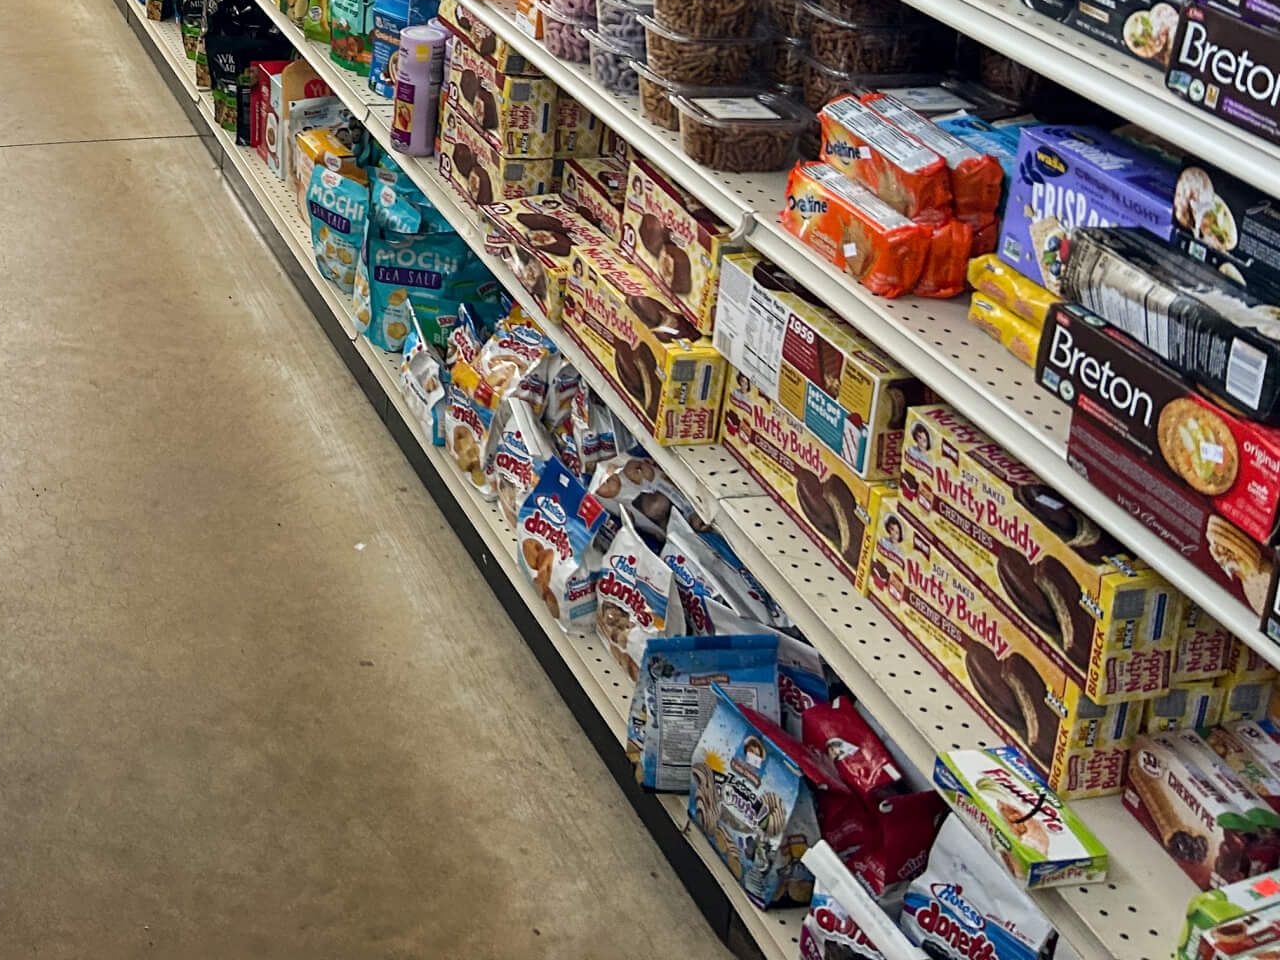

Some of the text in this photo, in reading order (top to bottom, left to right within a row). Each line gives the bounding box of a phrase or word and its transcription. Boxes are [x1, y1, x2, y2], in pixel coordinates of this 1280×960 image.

[1037, 151, 1066, 174] wasa
[308, 181, 365, 222] MOCHI
[645, 191, 668, 229] Nutty
[1123, 198, 1160, 225] LIGHT
[375, 247, 458, 272] MOCHI
[407, 268, 438, 286] SALT
[585, 288, 639, 344] Nutty Buddy
[789, 316, 815, 345] 1959
[1049, 324, 1154, 428] Breton
[680, 407, 711, 440] Nutty Buddy
[753, 404, 829, 478] Nutty Buddy
[882, 431, 904, 475] Buddy
[926, 408, 1037, 484] Nutty Buddy
[1243, 441, 1280, 472] original
[936, 466, 1041, 560] Nutty Buddy
[982, 480, 1006, 506] BAKED
[972, 526, 994, 550] PIES
[855, 534, 872, 594] BIG PACK
[907, 558, 1010, 661] Nutty Buddy
[940, 616, 964, 642] PIES
[1087, 629, 1105, 698] BIG PACK
[1125, 648, 1165, 693] Nutty Buddy
[1187, 628, 1227, 673] Nutty Buddy
[1050, 728, 1068, 791] BIG PACK
[1086, 746, 1124, 791] Nutty Buddy
[956, 792, 980, 820] Fruit
[1167, 771, 1215, 833] CHERRY PIE
